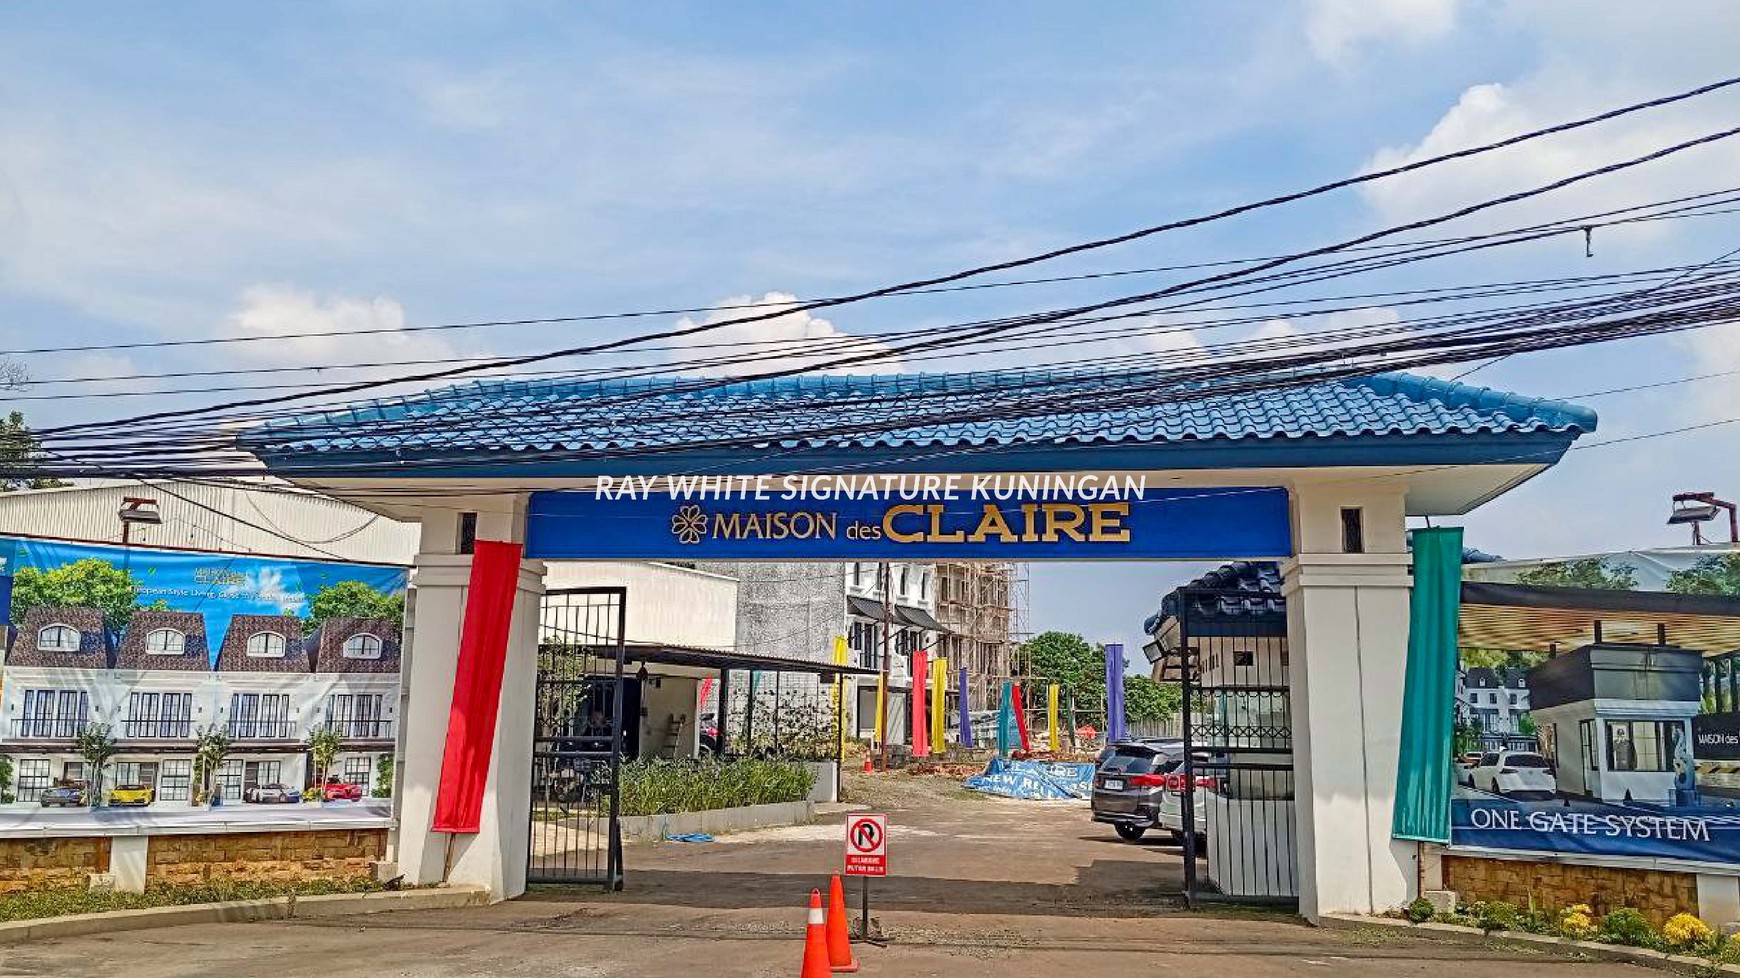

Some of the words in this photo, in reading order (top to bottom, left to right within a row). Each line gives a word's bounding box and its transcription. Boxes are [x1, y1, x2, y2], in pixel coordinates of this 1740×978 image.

[712, 511, 838, 540] MAISON
[846, 520, 882, 541] des
[882, 503, 1131, 543] CLAIRE
[1470, 808, 1521, 829] ONE
[1528, 811, 1597, 835] GATE
[1605, 815, 1710, 842] SYSTEM
